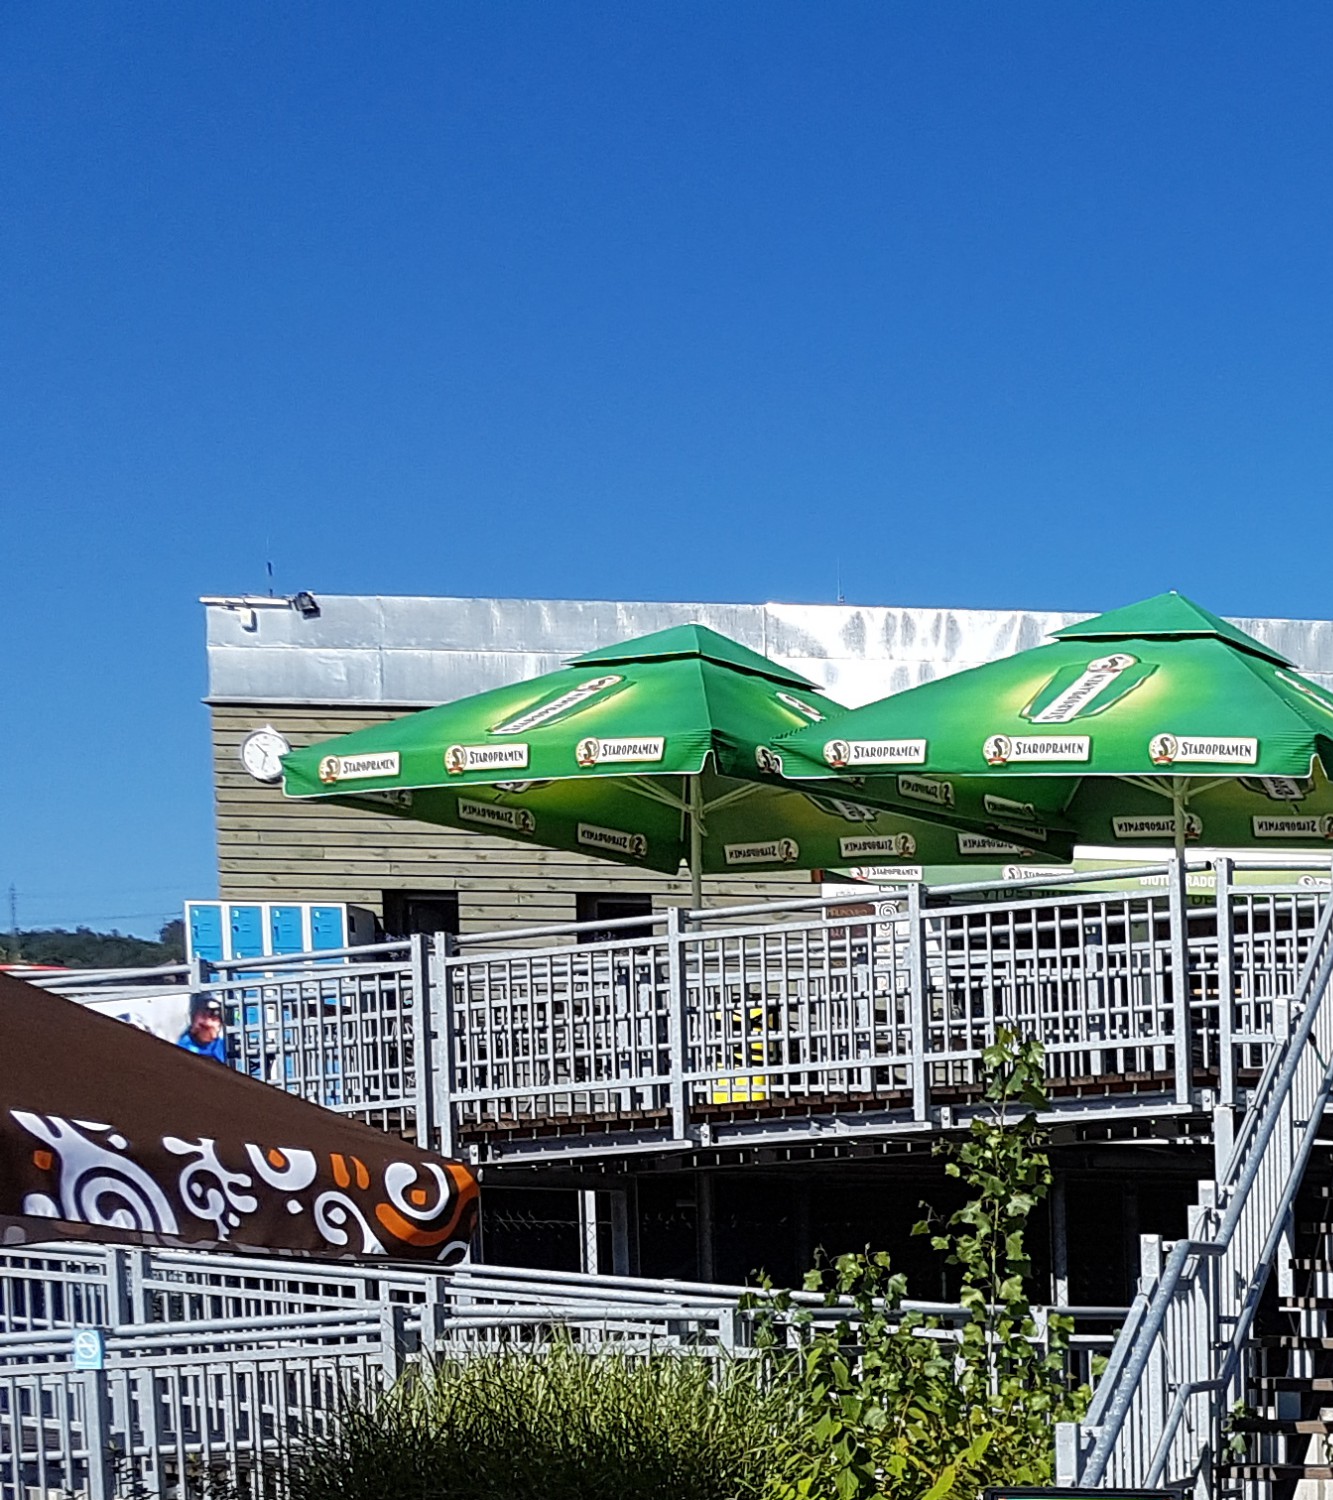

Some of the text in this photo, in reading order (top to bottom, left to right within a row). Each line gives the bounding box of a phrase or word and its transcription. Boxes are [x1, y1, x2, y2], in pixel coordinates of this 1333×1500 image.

[1043, 673, 1105, 720] STAROPRAMEN
[602, 743, 660, 757] STAROPRAMEN
[853, 745, 920, 759] STAROPRAMEN
[1016, 741, 1084, 755] STAROPRAMEN
[1181, 743, 1252, 757] STAROPRAMEN
[469, 749, 524, 765] STAROPRAMEN
[343, 758, 396, 774] STAROPRAMEN
